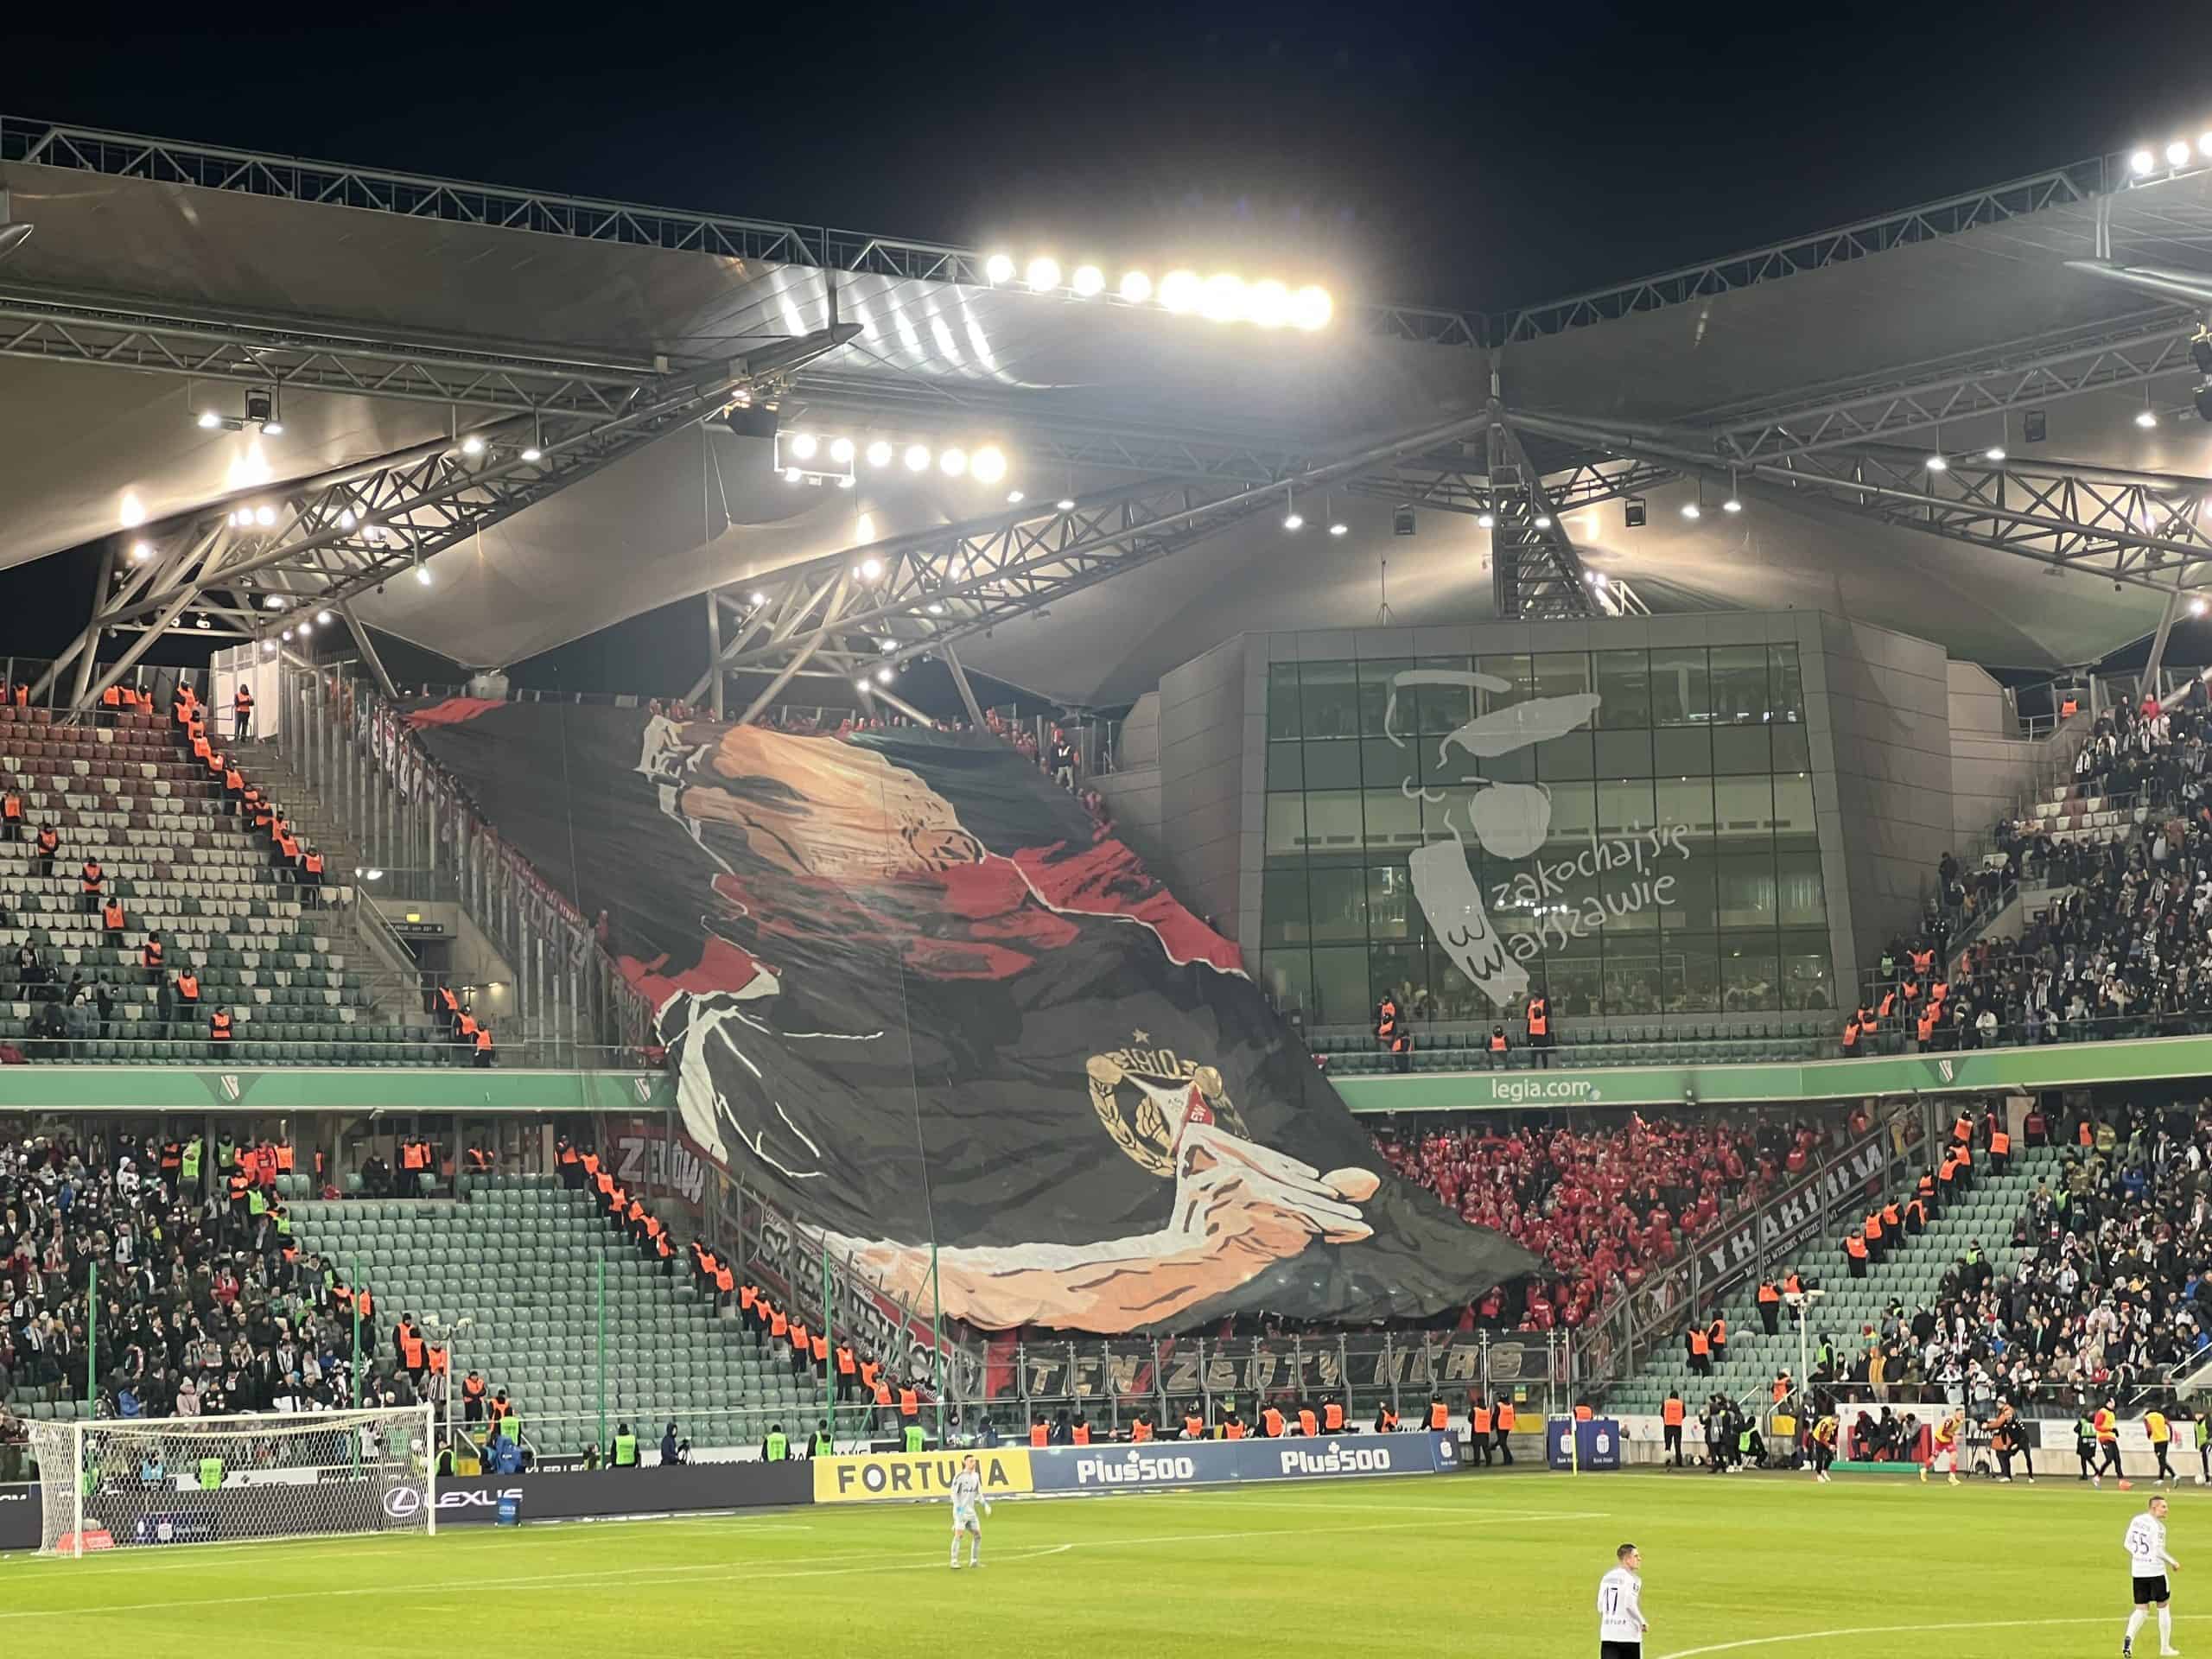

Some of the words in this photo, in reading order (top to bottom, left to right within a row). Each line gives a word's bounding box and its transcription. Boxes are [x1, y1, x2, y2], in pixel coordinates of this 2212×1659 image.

[1491, 819, 1642, 911] zakochaj
[1492, 1077, 1592, 1103] legia.com
[1077, 1451, 1194, 1484] Plus500
[1281, 1442, 1391, 1474] Plus500
